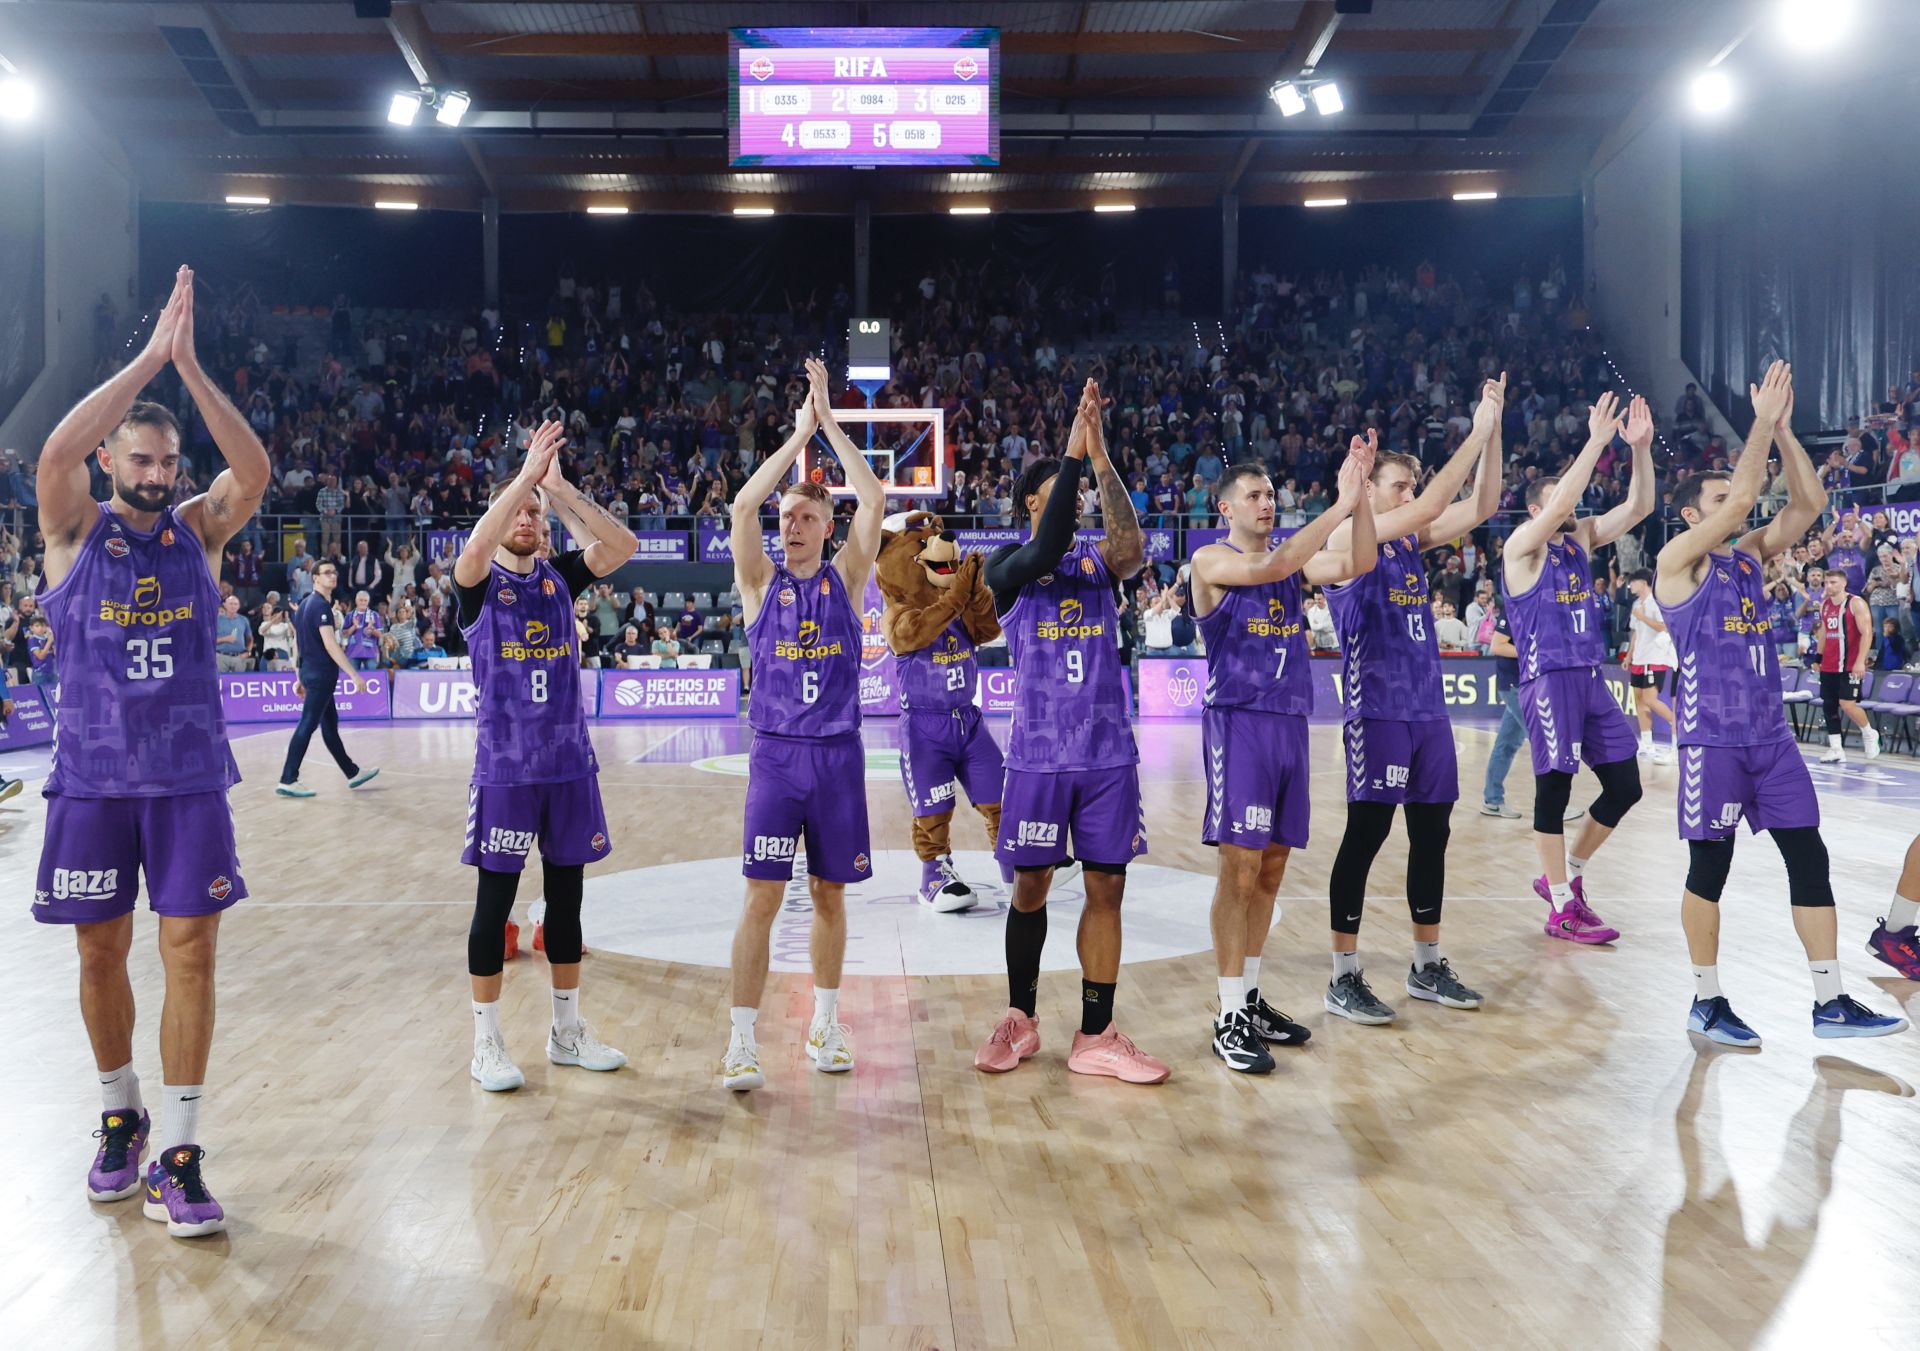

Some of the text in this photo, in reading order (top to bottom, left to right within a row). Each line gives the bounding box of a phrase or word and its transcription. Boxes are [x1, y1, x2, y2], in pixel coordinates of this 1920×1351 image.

[834, 56, 888, 77] RIFA
[747, 88, 966, 112] 1 0335 2 0984 3 0215
[781, 123, 925, 147] 4 0533 5 0518
[859, 321, 880, 333] 0.0
[1862, 507, 1920, 533] sltec
[959, 532, 1020, 540] AMBULANCIAS
[99, 602, 193, 627] agropal
[1407, 613, 1427, 641] 13
[1570, 608, 1585, 634] 17
[1827, 617, 1838, 629] 20
[1036, 620, 1105, 640] agropal
[126, 637, 174, 680] 35
[501, 642, 571, 661] agropal
[775, 641, 842, 660] agropal
[932, 648, 971, 665] agropal
[1749, 645, 1766, 677] 11
[1066, 650, 1084, 683] 9
[1274, 648, 1287, 679] 7
[531, 669, 548, 703] 8
[646, 678, 727, 692] HECHOS DE
[802, 671, 819, 704] 6
[946, 666, 965, 691] 23
[262, 702, 304, 713] CLÍNICAS
[646, 692, 720, 706] PALENCIA
[488, 827, 533, 853] gaza
[1017, 820, 1059, 847] gaza
[754, 835, 795, 861] gaza
[52, 867, 119, 900] gaza
